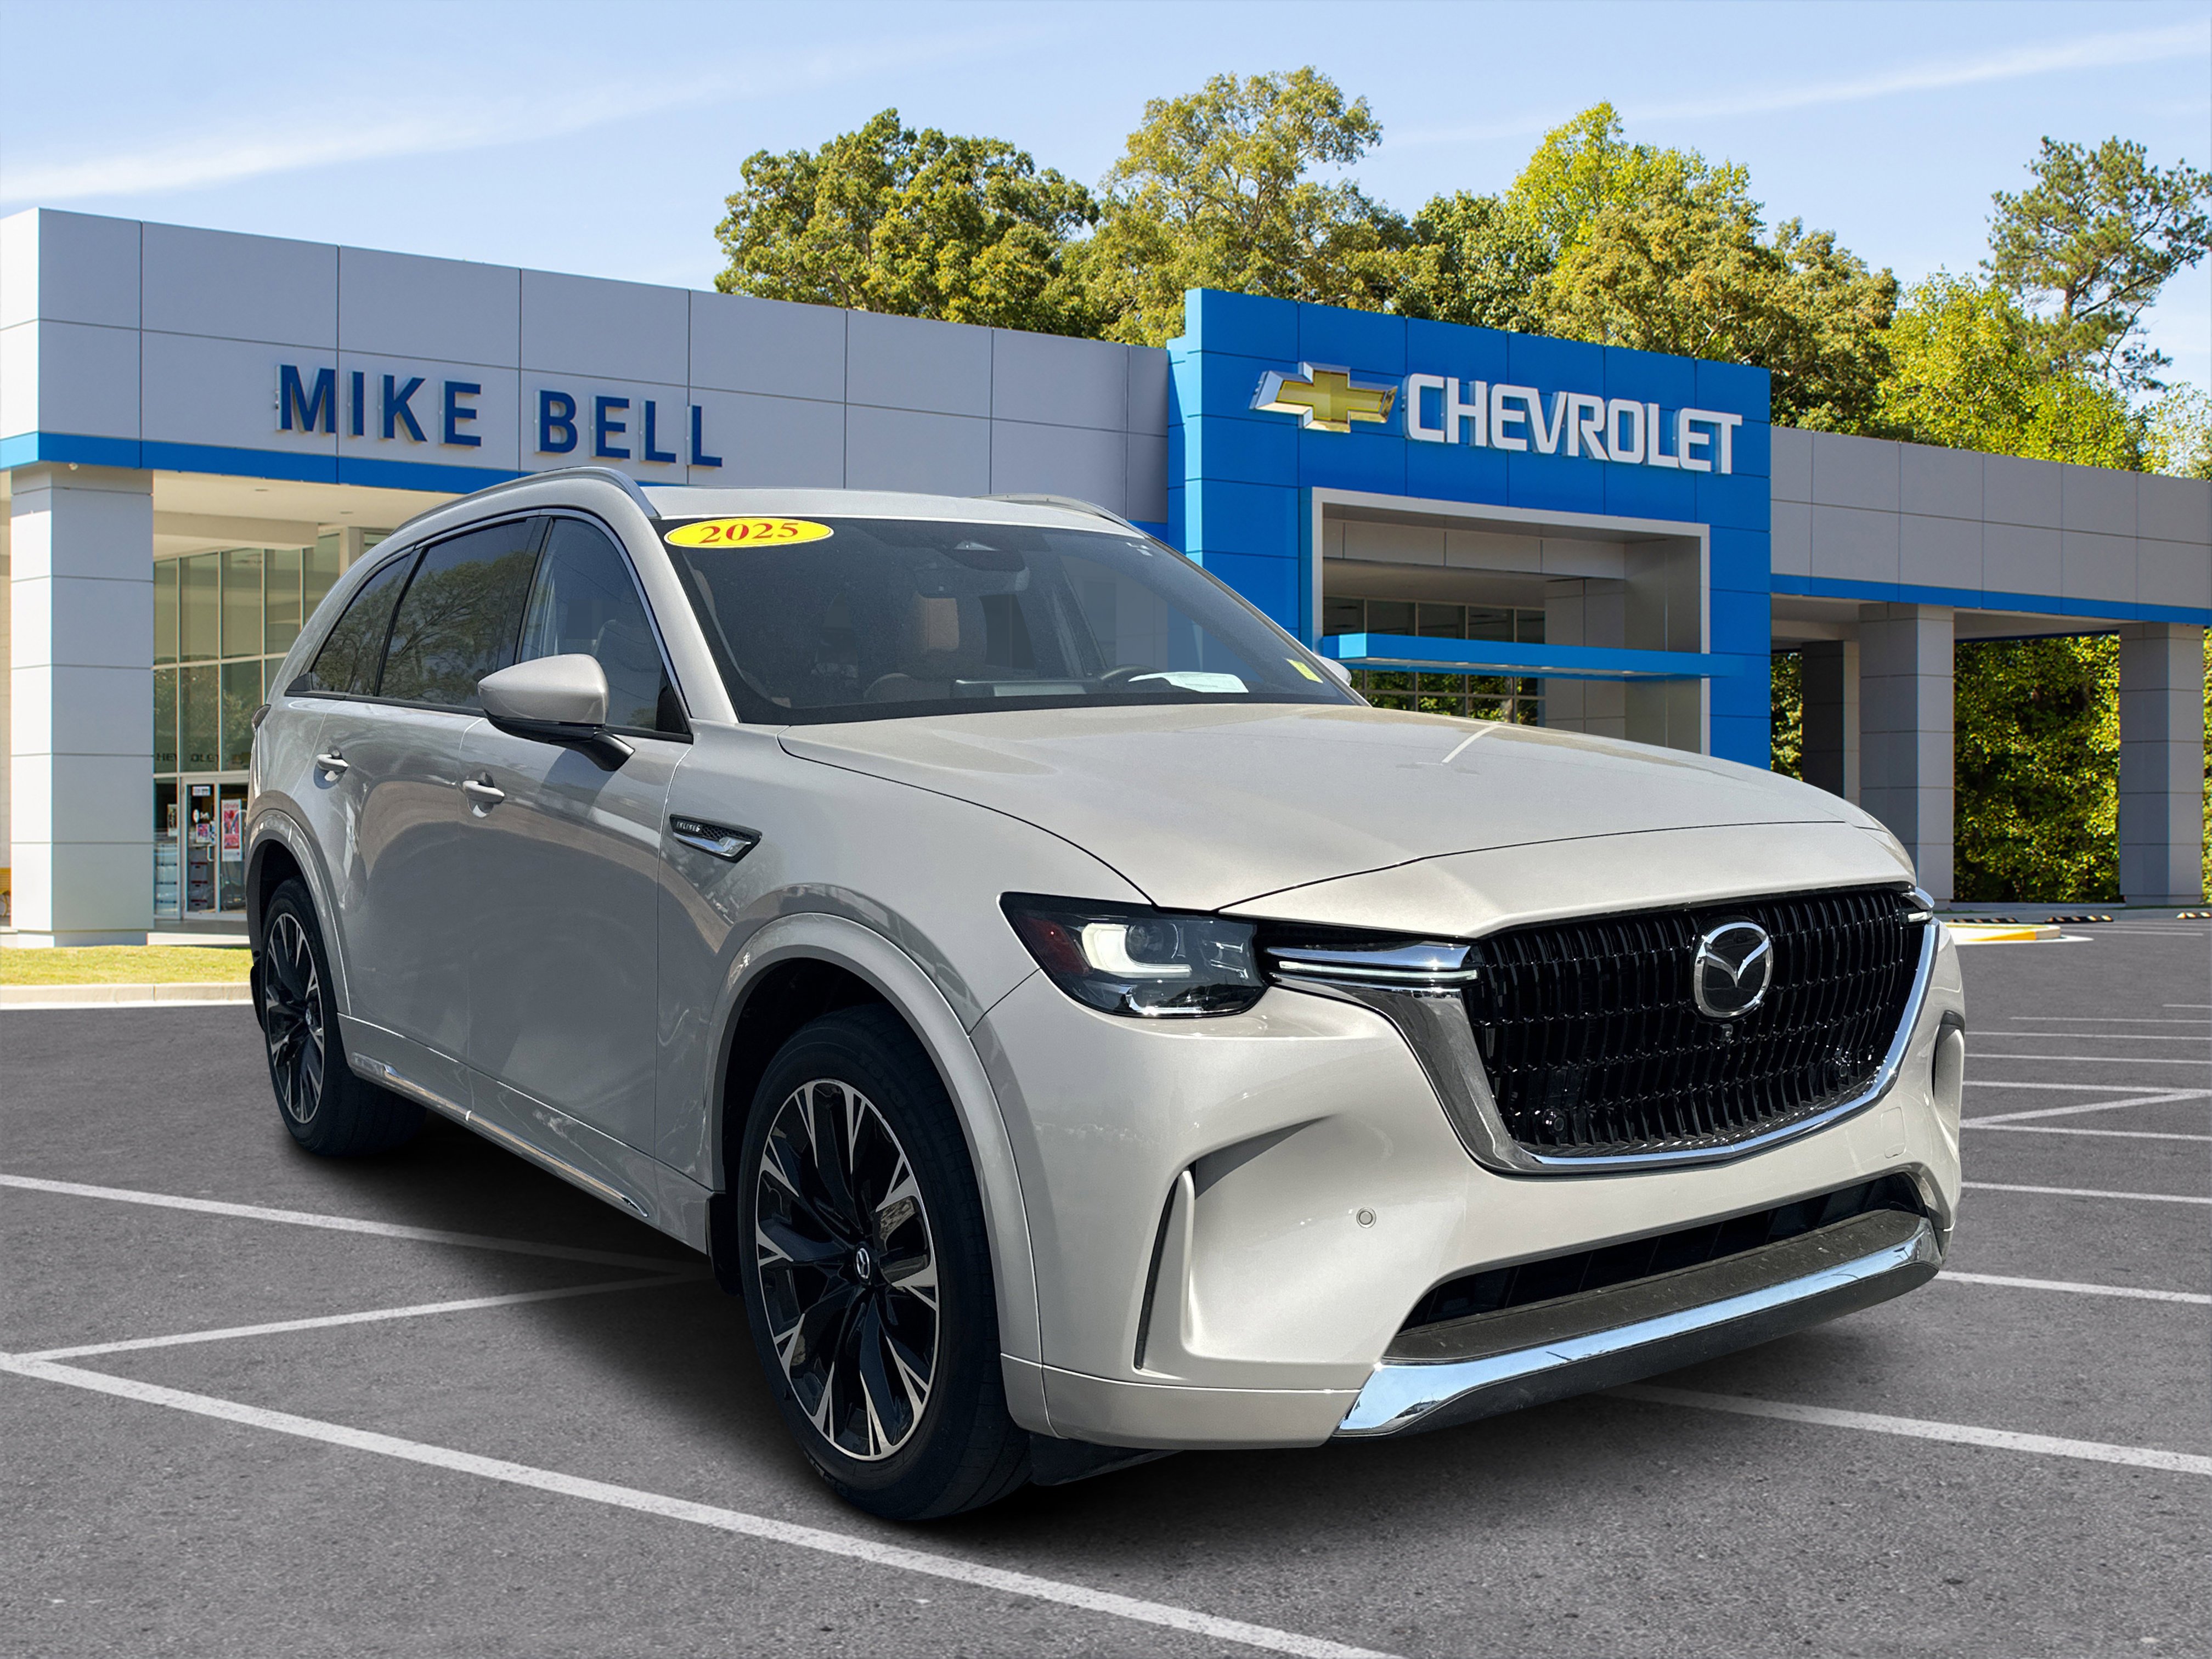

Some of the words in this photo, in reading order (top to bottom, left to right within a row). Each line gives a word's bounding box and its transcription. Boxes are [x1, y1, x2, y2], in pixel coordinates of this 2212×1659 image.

[277, 364, 481, 447] MIKE
[535, 390, 723, 468] BELL
[1403, 373, 1743, 474] CHEVROLET
[698, 522, 799, 544] 2025
